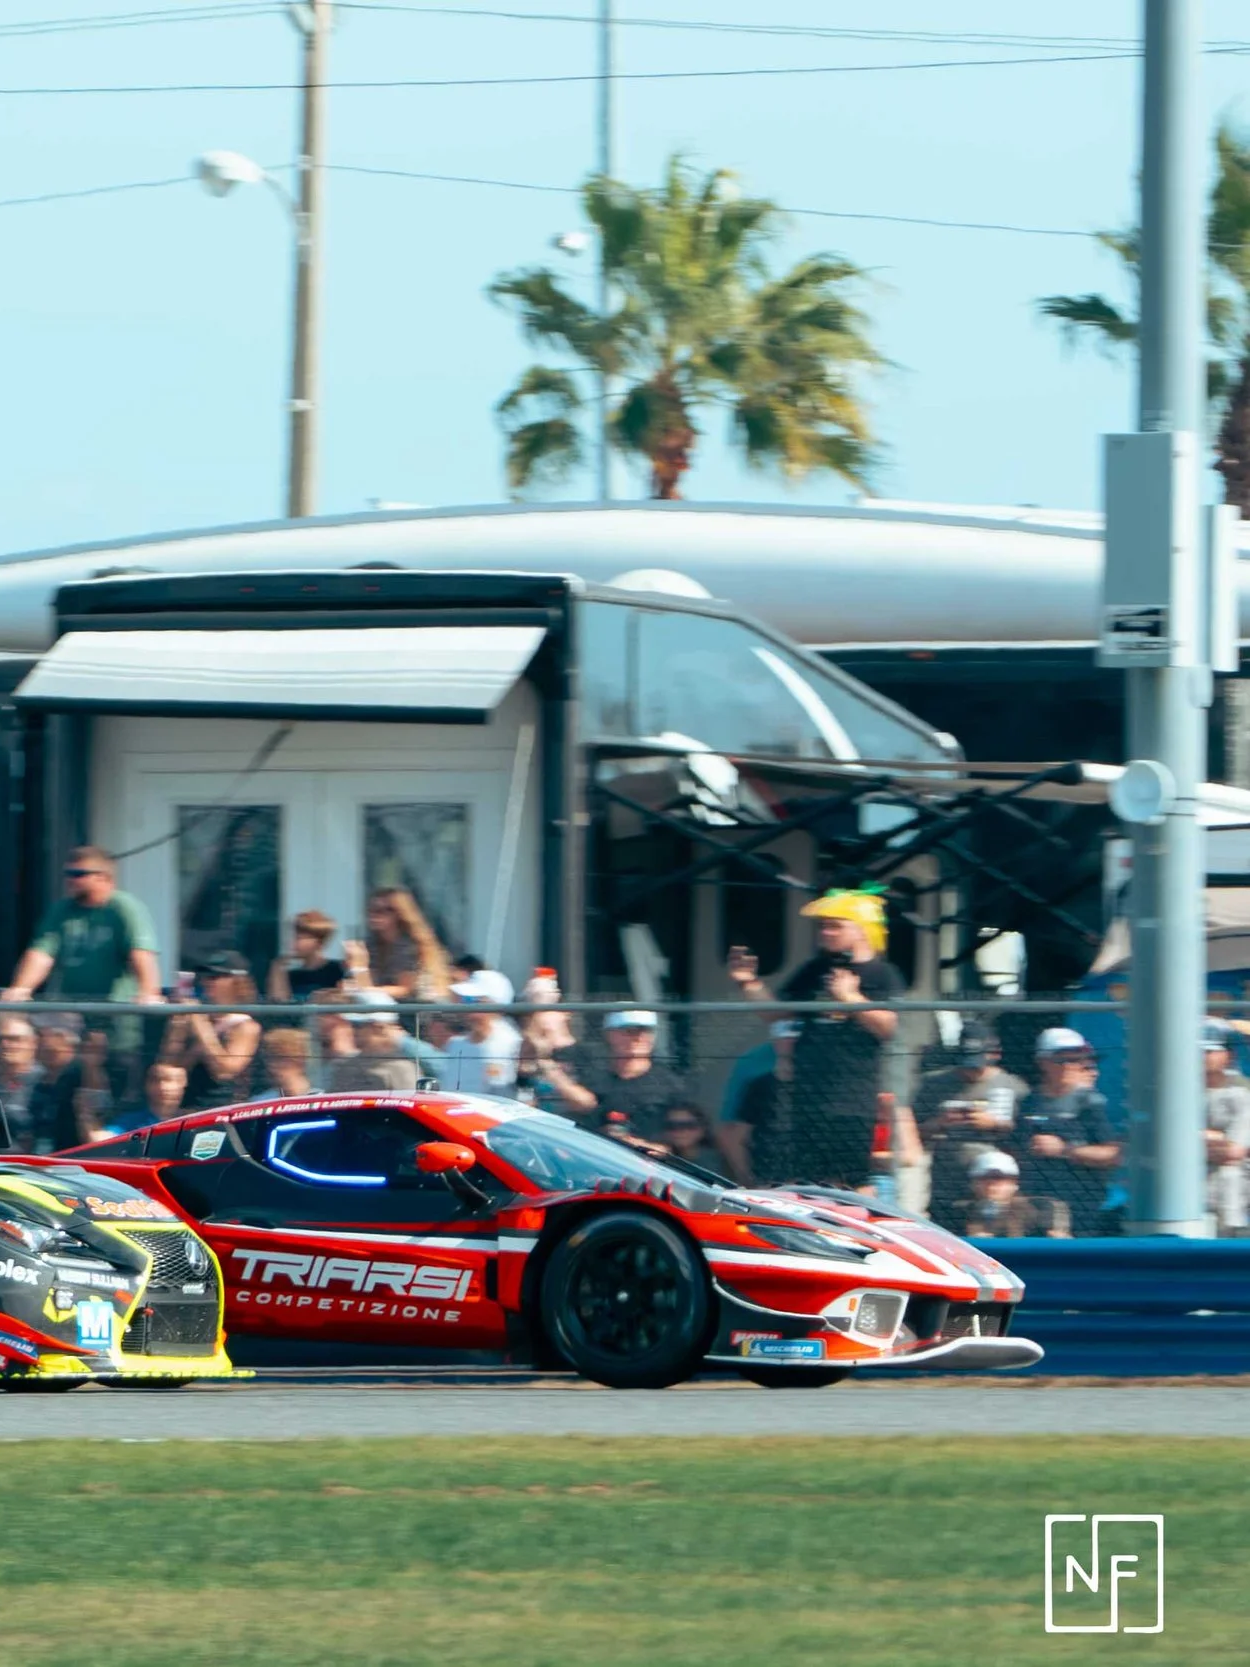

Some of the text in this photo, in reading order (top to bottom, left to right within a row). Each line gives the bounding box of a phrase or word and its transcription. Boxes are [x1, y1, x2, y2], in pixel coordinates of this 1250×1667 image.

[231, 1248, 474, 1302] TRIARSI
[81, 1304, 111, 1339] M
[236, 1290, 461, 1323] COMPETIZIONE
